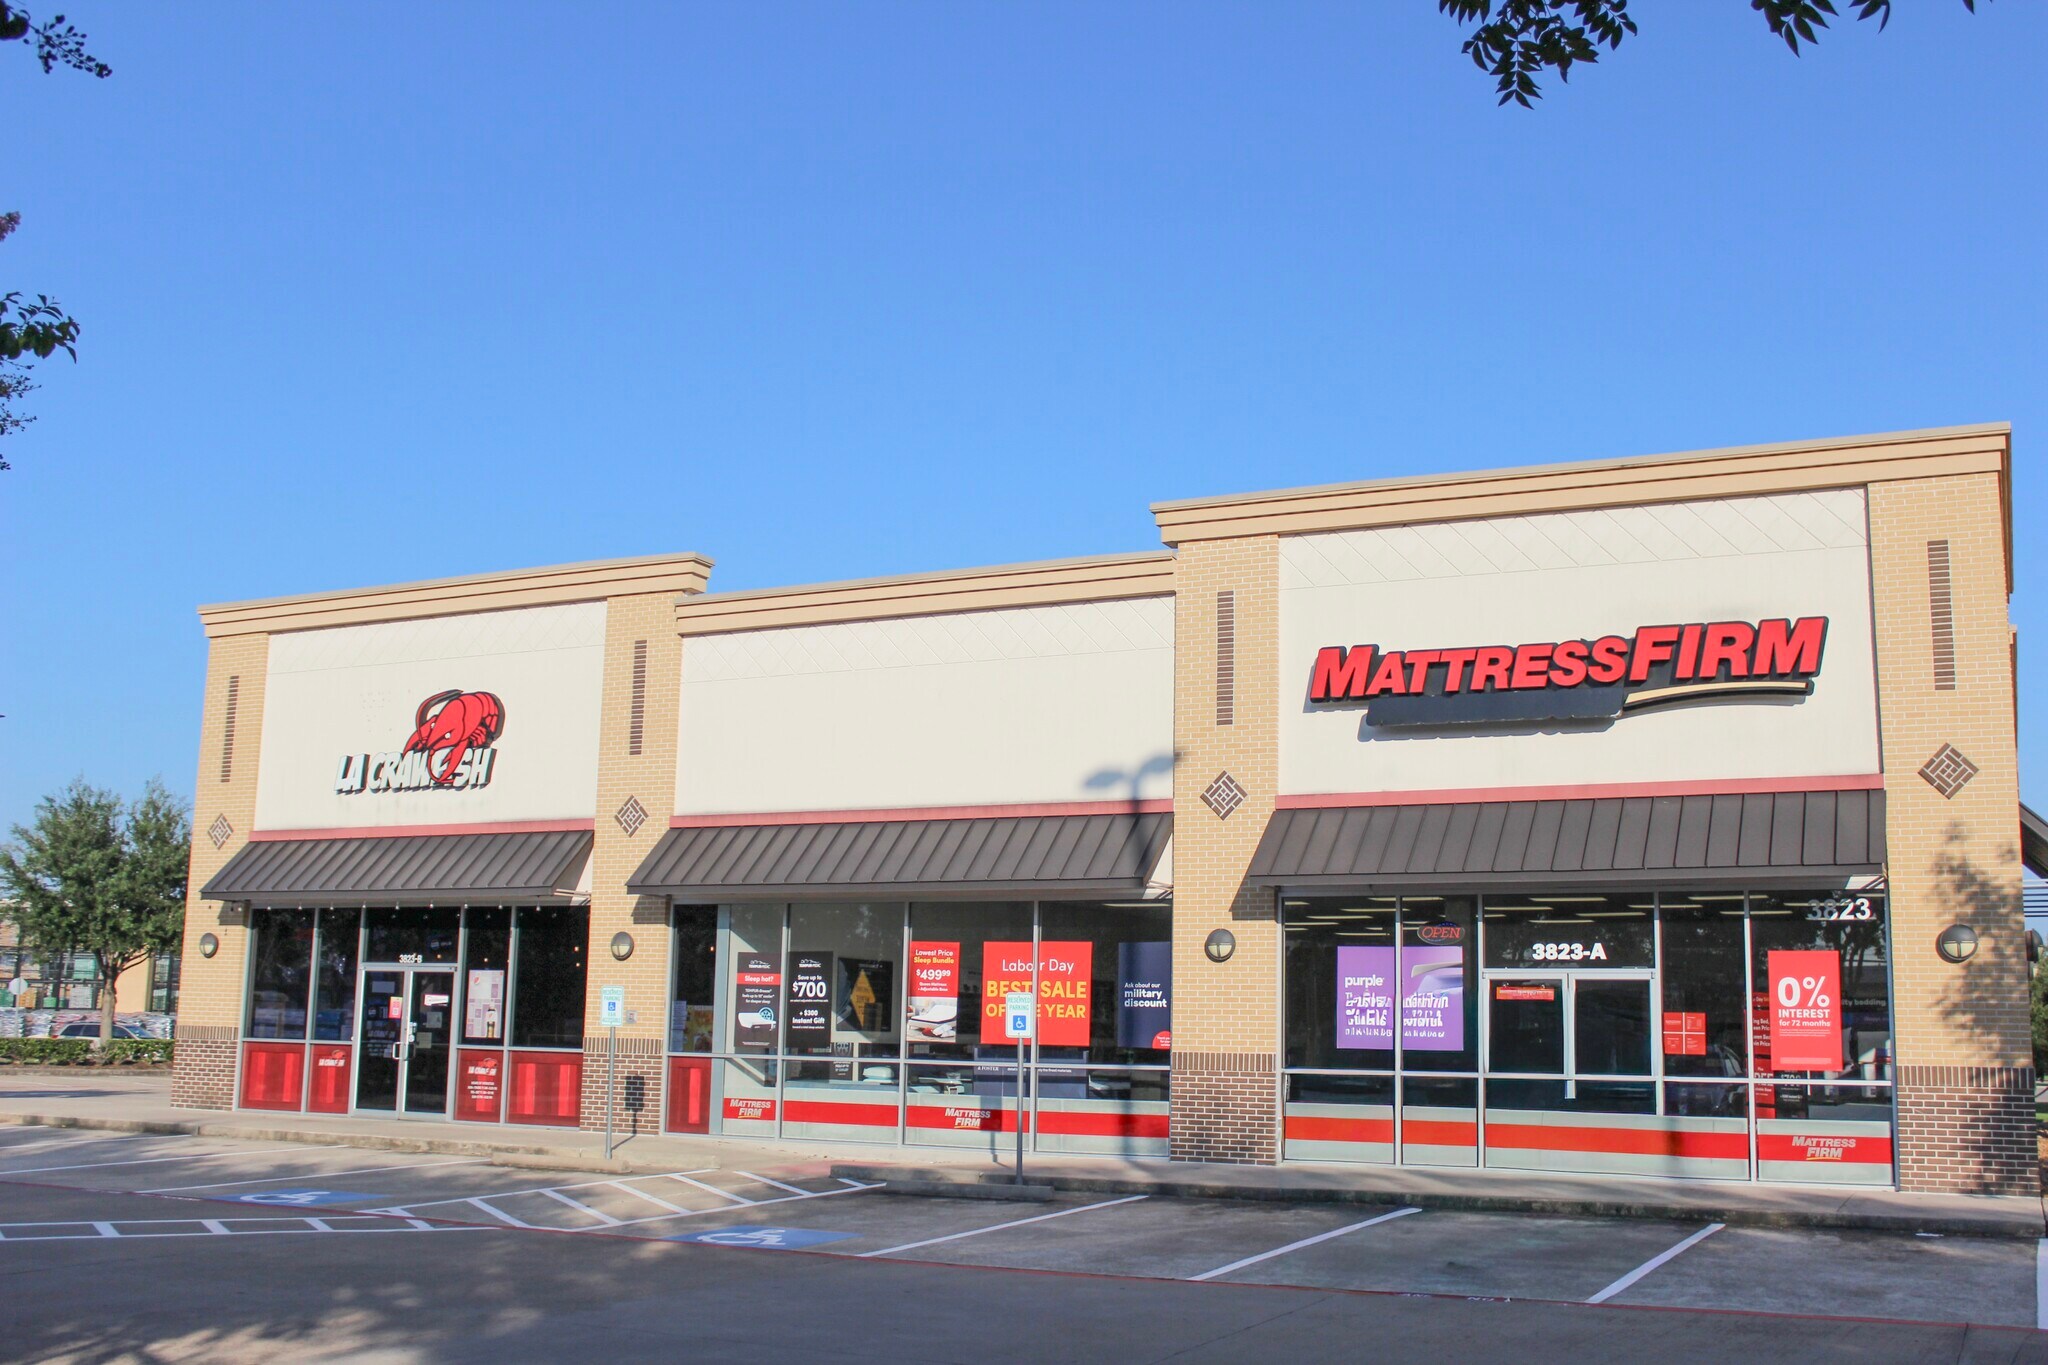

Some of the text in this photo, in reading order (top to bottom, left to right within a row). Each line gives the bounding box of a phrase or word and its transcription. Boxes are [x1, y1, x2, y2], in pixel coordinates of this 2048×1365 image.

[335, 753, 369, 793] LA
[1807, 897, 1872, 920] 3823
[1422, 926, 1461, 938] OPEN
[938, 949, 954, 957] Price
[1532, 942, 1608, 961] 3823-A
[399, 953, 423, 963] 3823-B
[913, 956, 931, 964] Sleep
[1049, 958, 1075, 975] Day
[744, 975, 775, 984] Sleep hot?
[792, 980, 827, 999] $700
[1040, 980, 1087, 998] SALE
[1777, 975, 1831, 1008] 0%
[1124, 989, 1163, 1000] military
[1124, 999, 1168, 1008] discount
[1854, 999, 1886, 1007] bedding
[1045, 1004, 1086, 1018] YEAR
[1778, 1009, 1830, 1019] INTEREST
[1779, 1019, 1831, 1027] for 72 months
[730, 1099, 771, 1109] MATTRESS
[738, 1108, 762, 1117] FIRM
[944, 1108, 991, 1118] MATTRESS
[954, 1118, 981, 1127] FIRM
[1791, 1135, 1857, 1148] MATTRESS
[1806, 1147, 1843, 1158] FIRM
